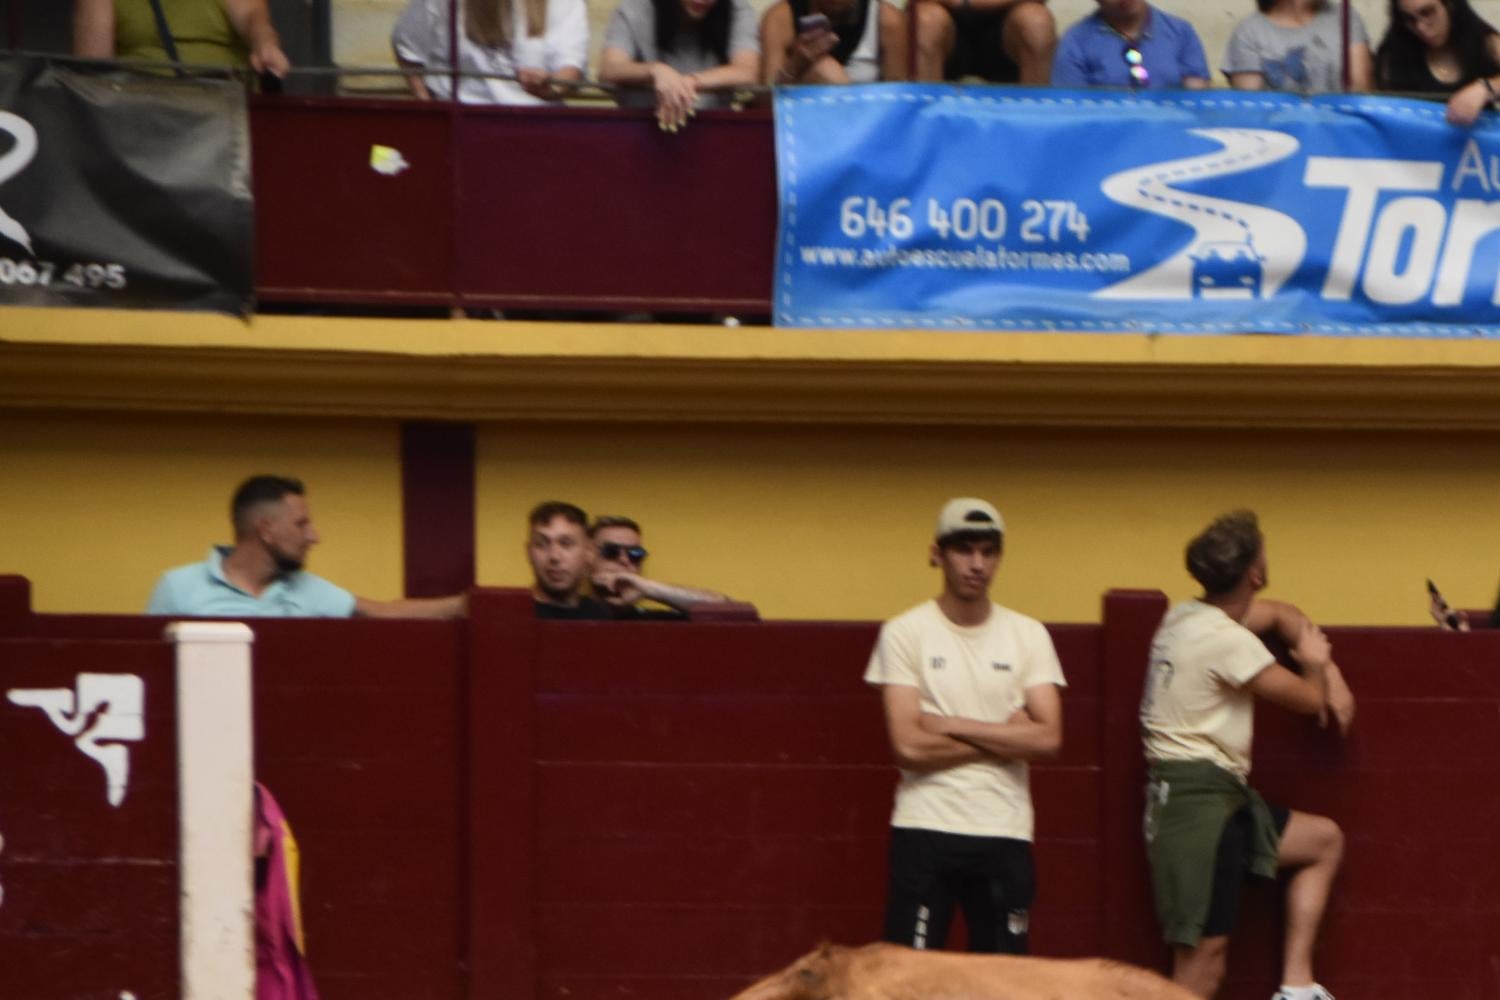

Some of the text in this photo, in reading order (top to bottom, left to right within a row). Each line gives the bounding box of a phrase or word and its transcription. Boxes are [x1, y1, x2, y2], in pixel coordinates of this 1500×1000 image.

[840, 196, 1090, 242] 646 400 274
[800, 243, 1131, 273] www.autoescuelatormes.com
